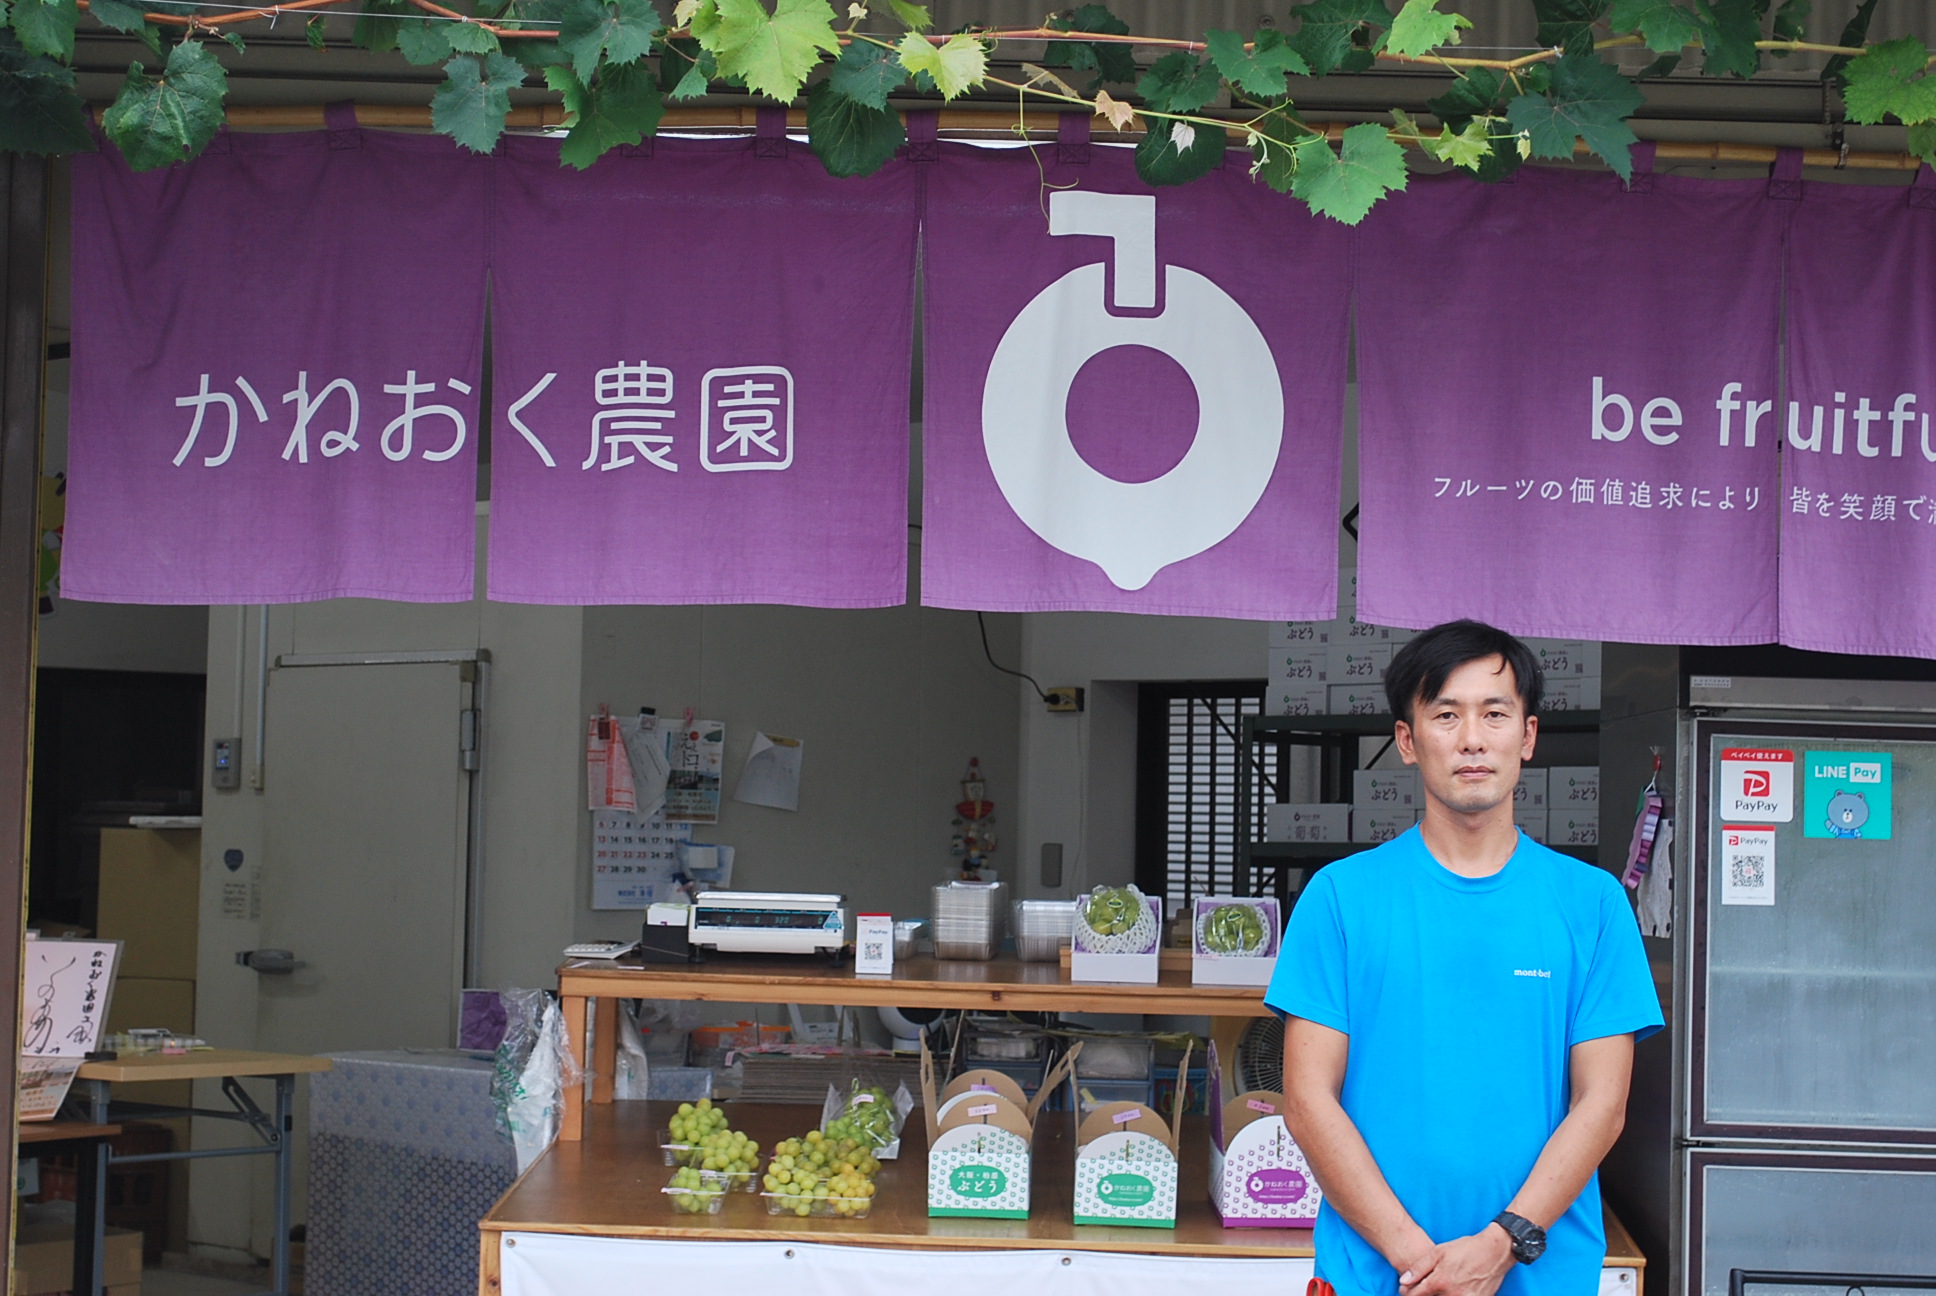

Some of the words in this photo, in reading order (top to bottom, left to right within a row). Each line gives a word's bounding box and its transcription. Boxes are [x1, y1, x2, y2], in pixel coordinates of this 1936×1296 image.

[172, 360, 794, 473] かねおく農園
[1591, 376, 1683, 446] be
[1433, 476, 1761, 512] フルーツの価値追求により
[1814, 765, 1847, 778] LINE
[1854, 766, 1877, 779] Pay
[1735, 800, 1778, 813] PayPay
[638, 836, 646, 844] 16
[1740, 837, 1768, 846] PayPay
[610, 850, 618, 858] 21
[650, 851, 660, 859] 24
[664, 851, 674, 859] 25
[597, 865, 607, 873] 27
[610, 865, 619, 873] 28
[957, 1180, 997, 1193] ぶどう
